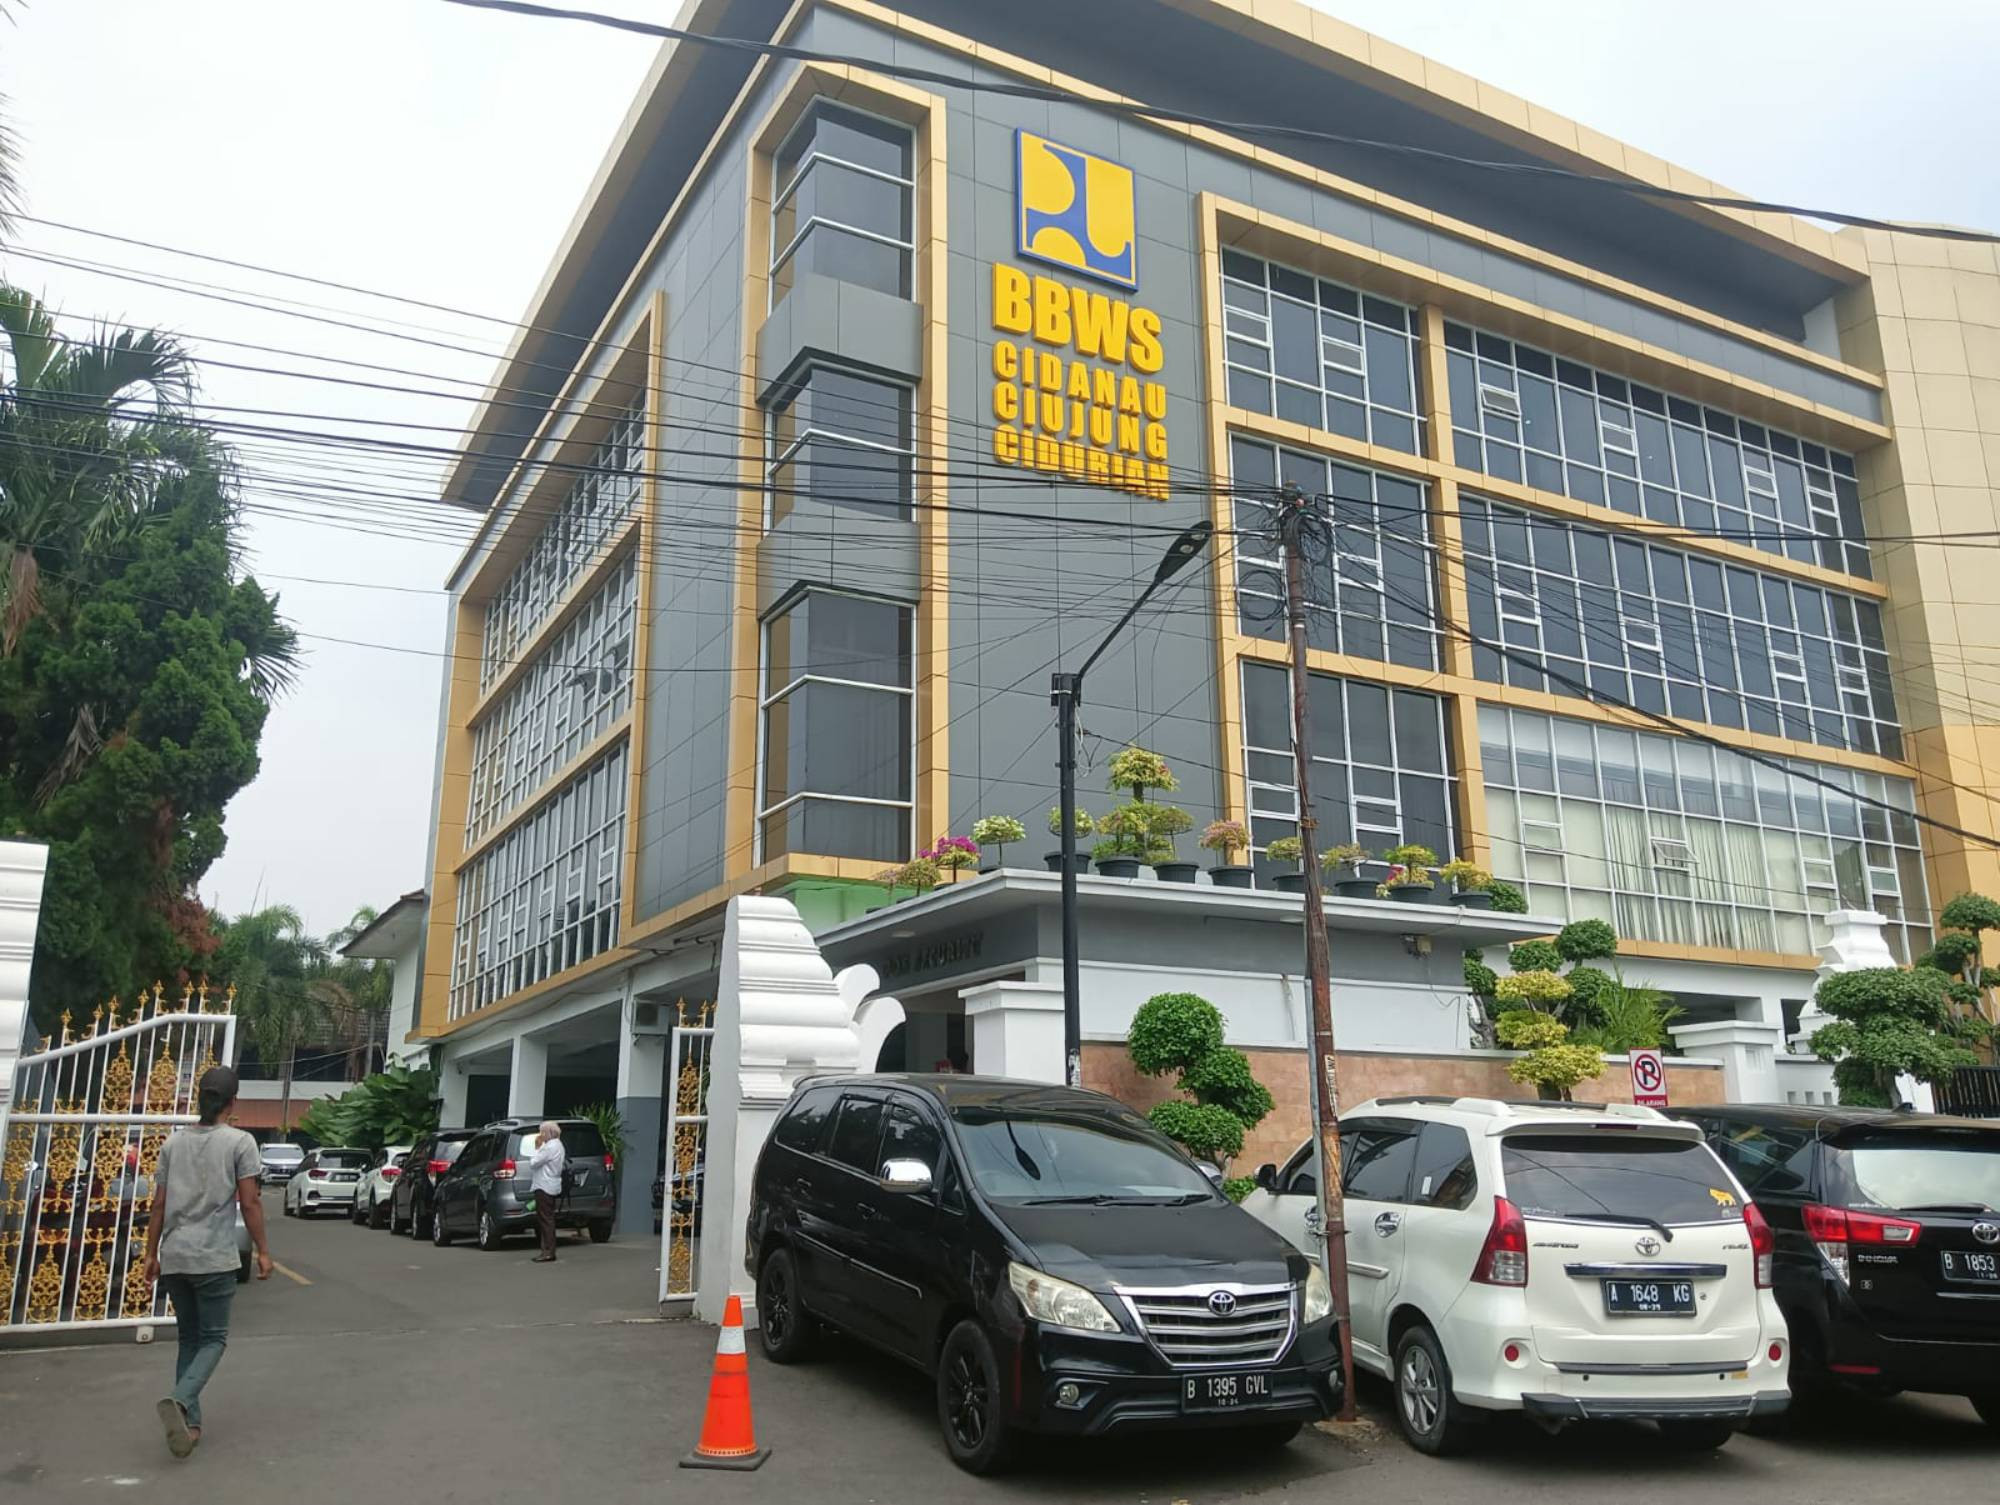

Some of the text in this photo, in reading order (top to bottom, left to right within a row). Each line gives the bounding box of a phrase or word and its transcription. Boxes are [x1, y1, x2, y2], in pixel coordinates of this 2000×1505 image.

[992, 262, 1164, 373] BBWS
[992, 340, 1167, 420] CIDANAU
[993, 381, 1168, 461] CIUJUNG
[993, 424, 1170, 500] CIDURIAN
[1611, 1284, 1690, 1303] A 1648 KG
[1944, 1253, 1995, 1271] B 1853
[1187, 1374, 1268, 1399] B 1395 GVL
